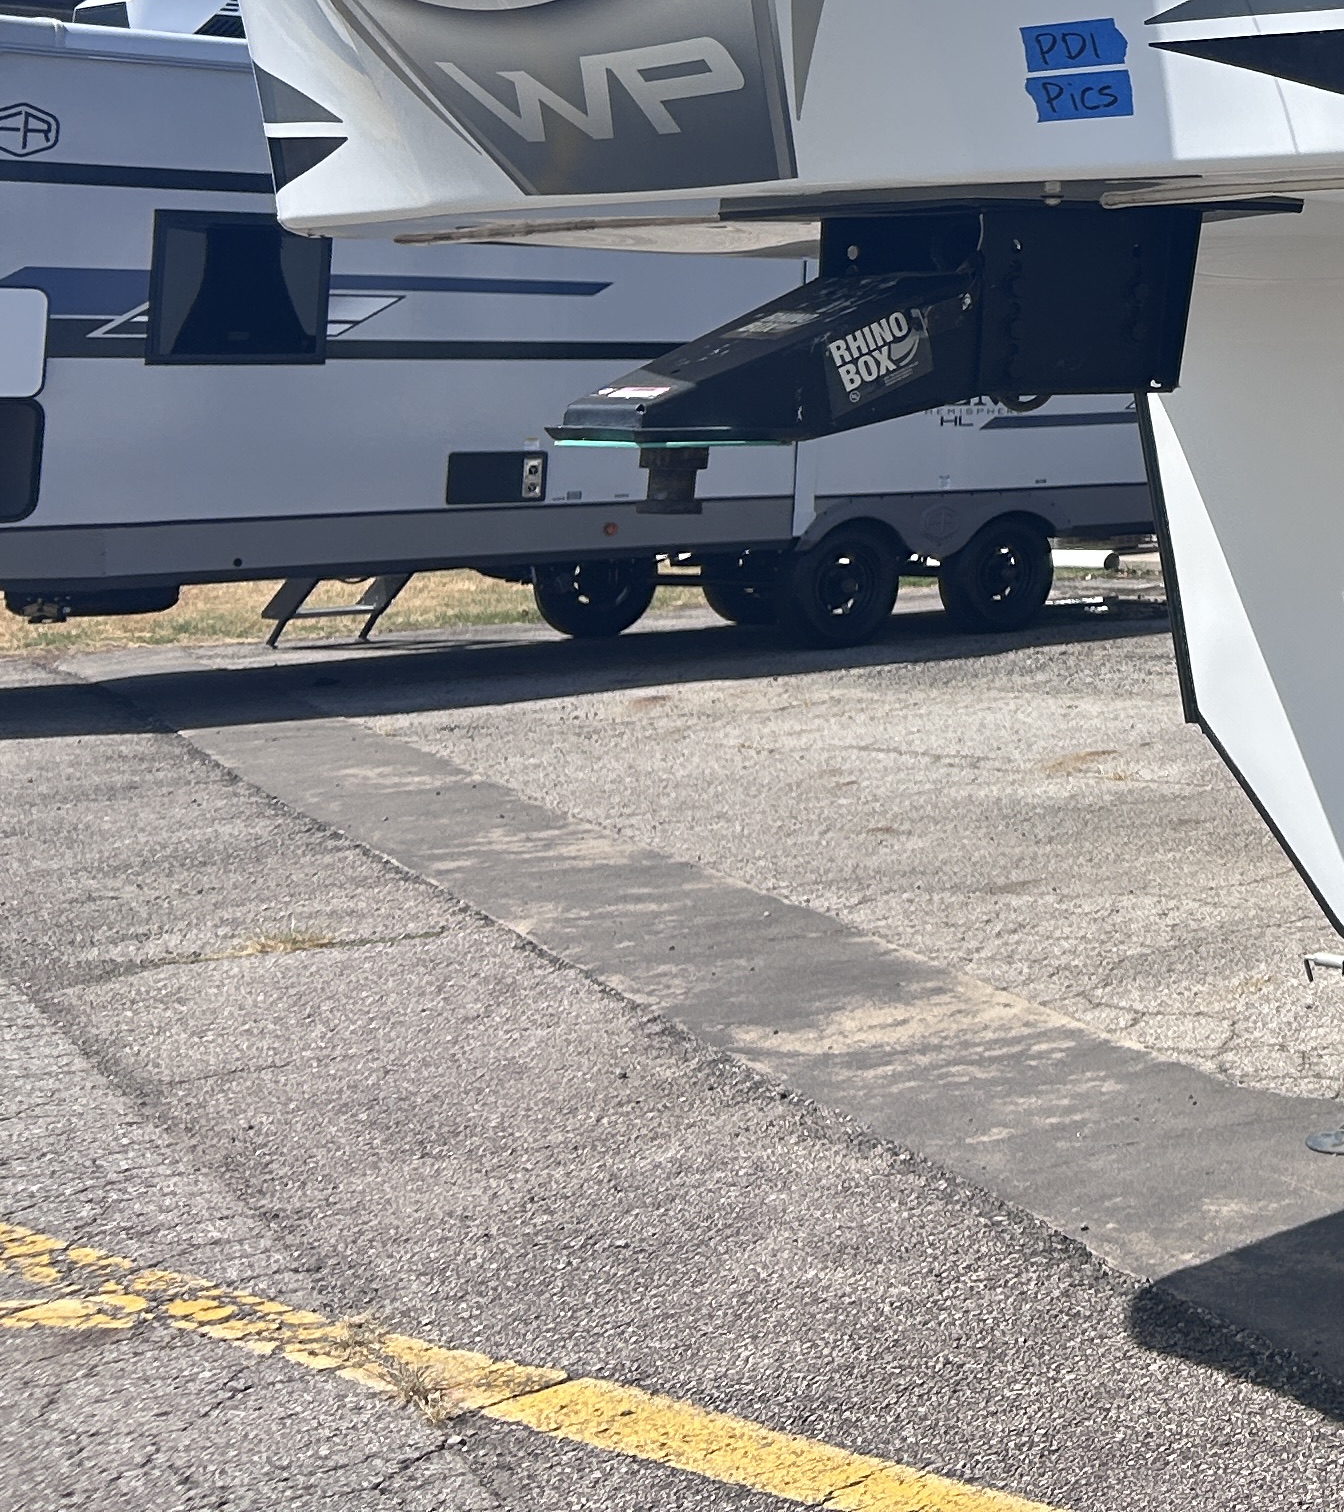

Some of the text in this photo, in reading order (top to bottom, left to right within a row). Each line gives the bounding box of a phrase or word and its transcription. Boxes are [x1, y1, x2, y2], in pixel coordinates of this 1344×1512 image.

[1035, 32, 1101, 66] PDI
[434, 36, 746, 143] WP
[829, 311, 909, 367] RHINO
[838, 346, 897, 392] BOX
[924, 406, 1022, 416] HEMISPHER
[940, 415, 974, 427] HL
